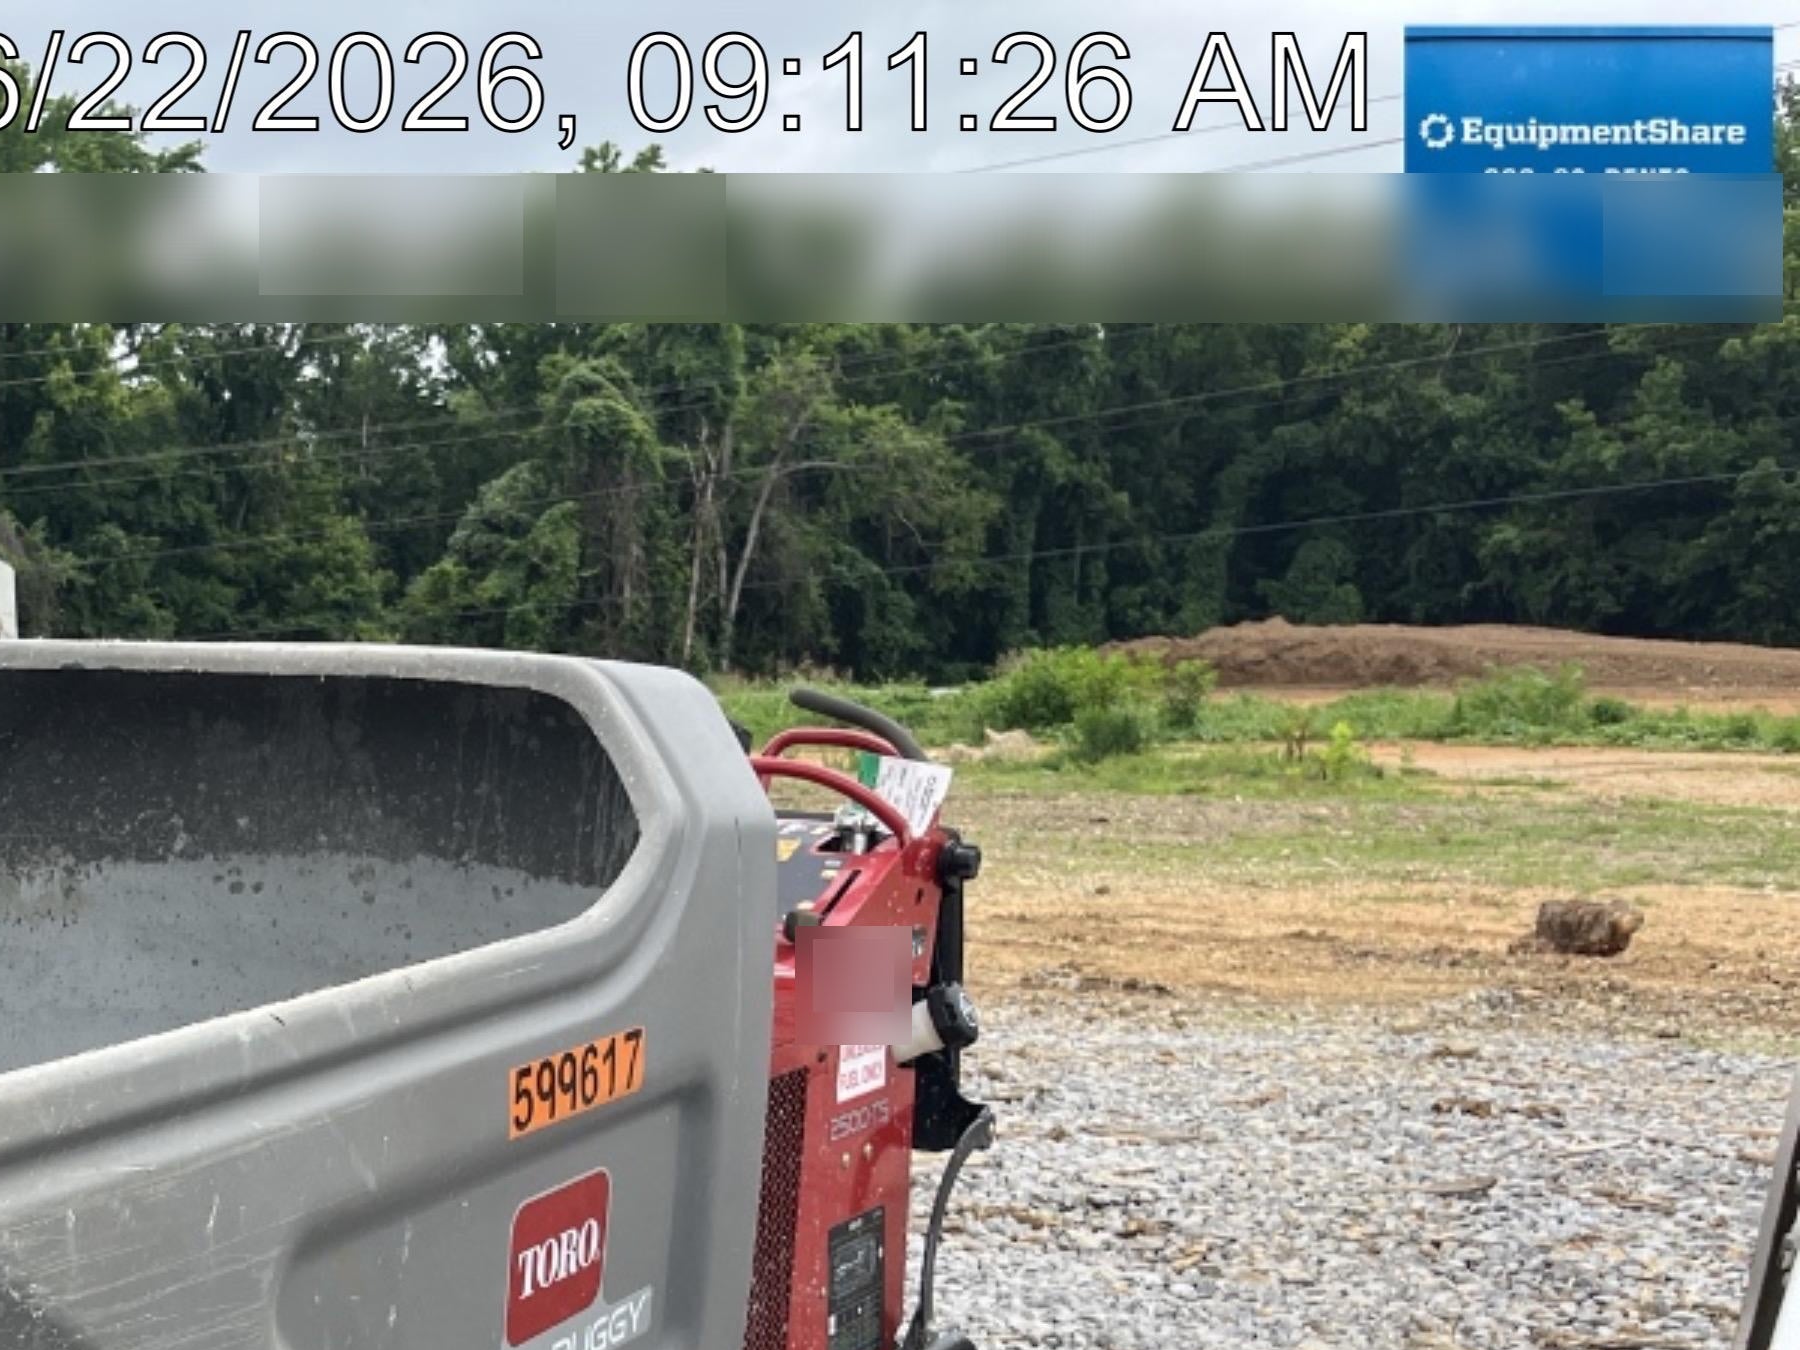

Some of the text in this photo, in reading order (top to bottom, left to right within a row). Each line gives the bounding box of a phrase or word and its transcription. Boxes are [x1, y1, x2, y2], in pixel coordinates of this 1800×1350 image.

[1461, 117, 1746, 150] EquipmentShare
[513, 1029, 643, 1132] 599617
[518, 1217, 600, 1300] TORO
